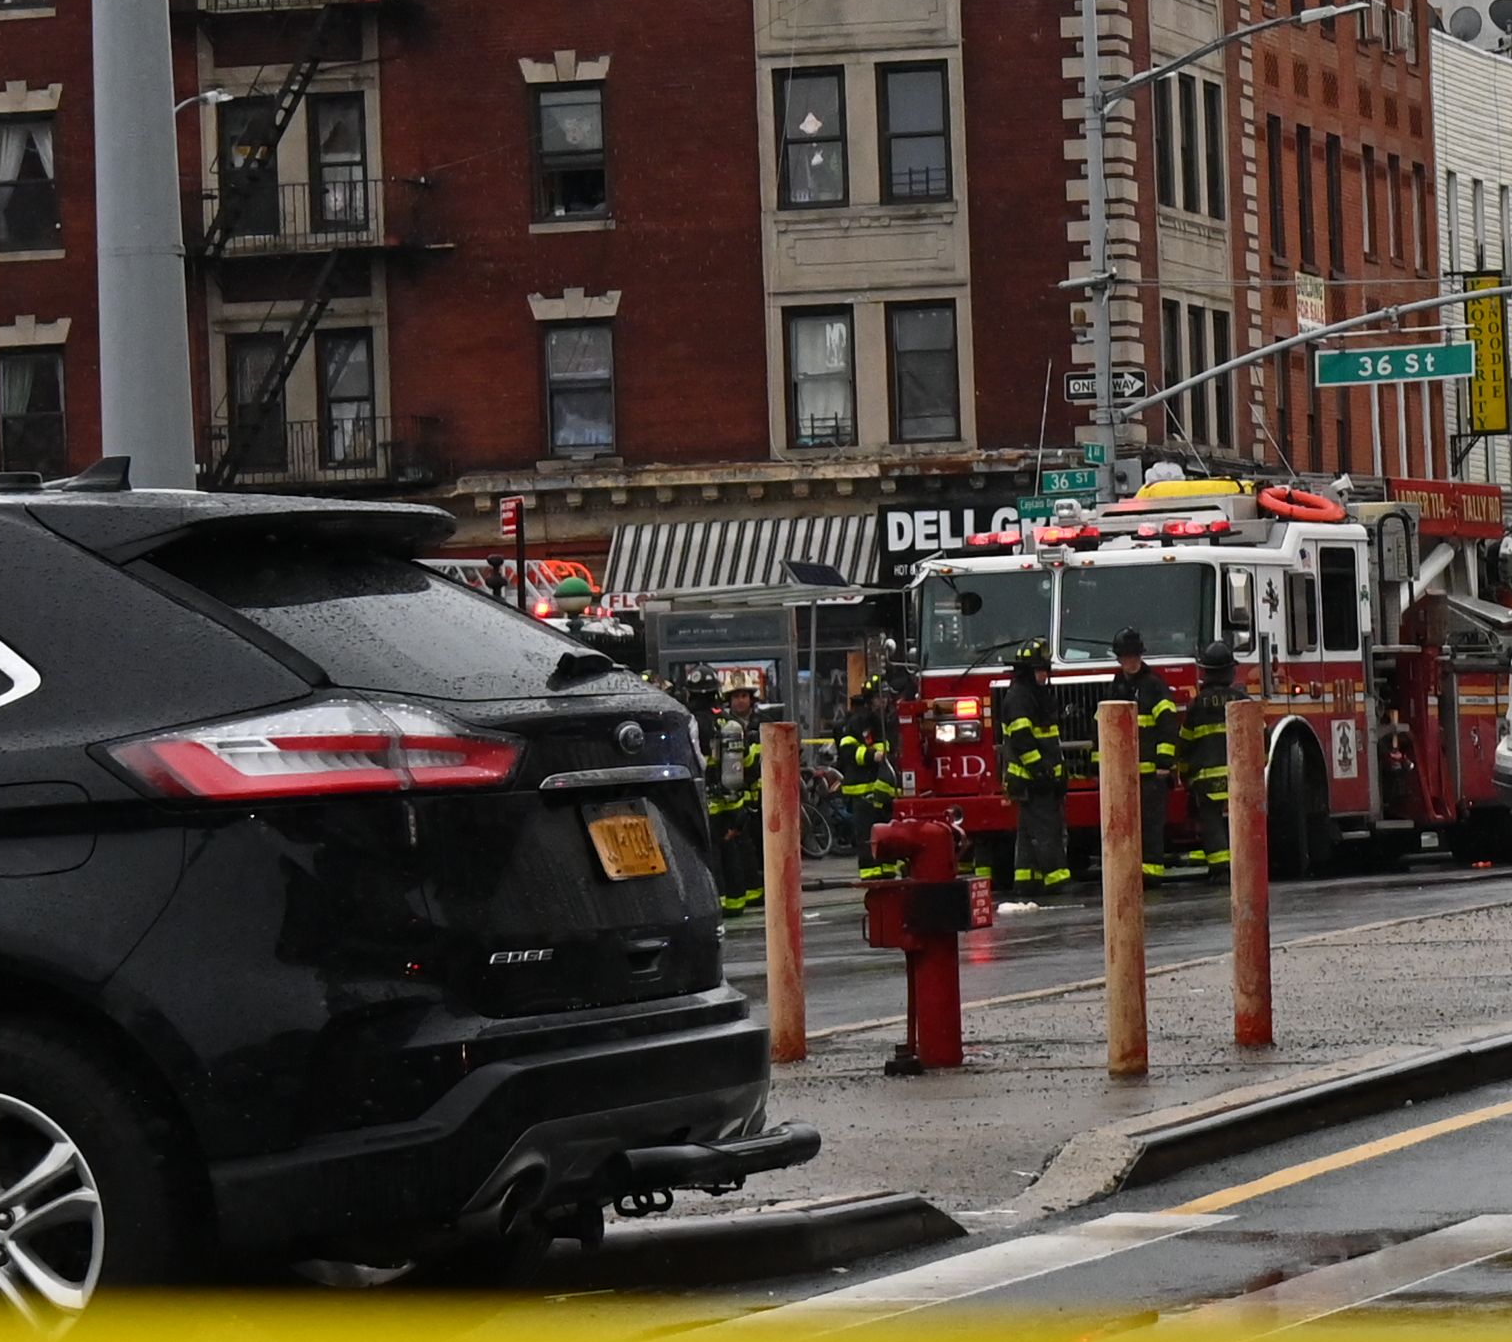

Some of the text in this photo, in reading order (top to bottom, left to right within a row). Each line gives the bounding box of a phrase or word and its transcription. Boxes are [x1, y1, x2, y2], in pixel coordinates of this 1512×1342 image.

[1358, 353, 1435, 376] 36 St
[1073, 379, 1136, 392] ONE WAY
[1051, 473, 1089, 489] 36 ST
[1461, 495, 1487, 522] TALLY
[936, 755, 991, 778] F.D.
[489, 948, 554, 965] EDGE
